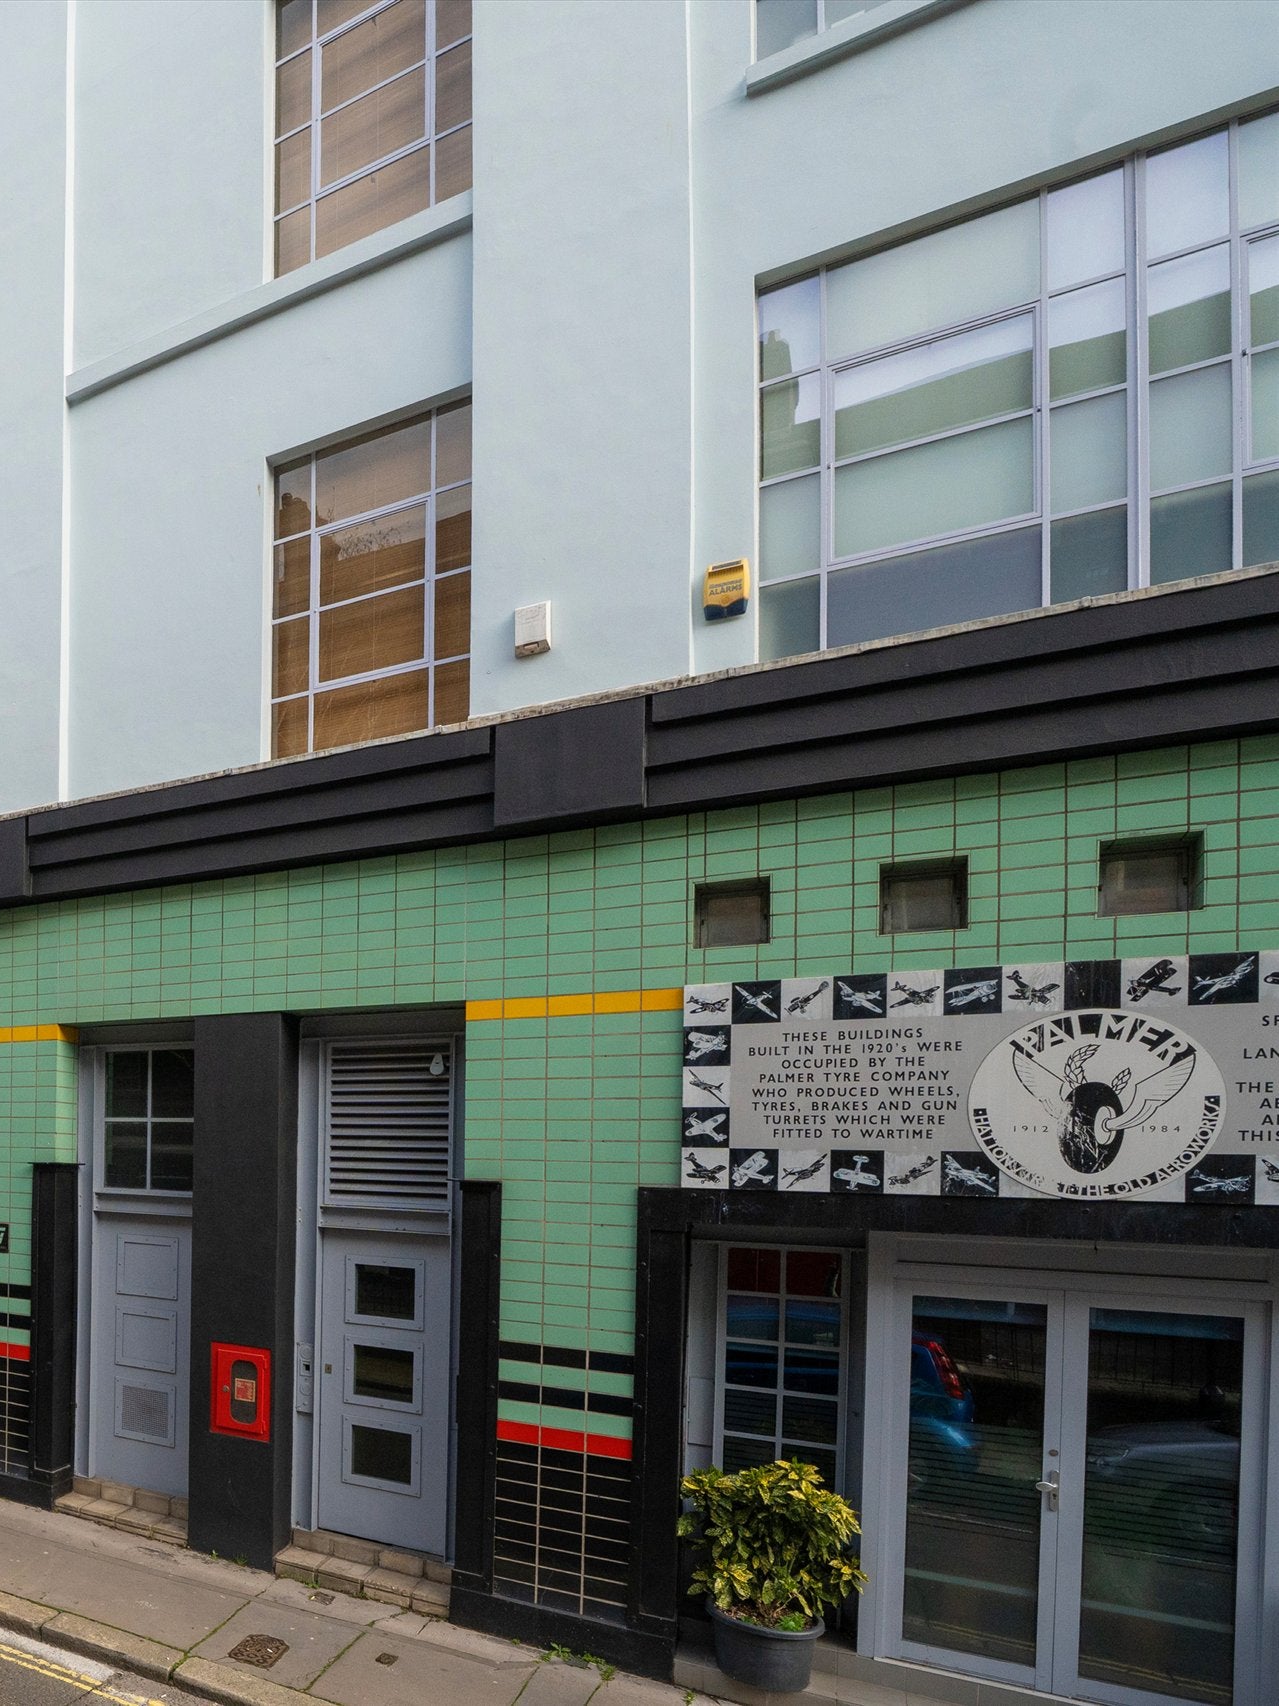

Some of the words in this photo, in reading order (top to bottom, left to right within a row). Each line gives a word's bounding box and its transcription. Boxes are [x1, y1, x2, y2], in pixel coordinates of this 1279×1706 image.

[782, 1031, 828, 1042] THESE
[838, 1028, 923, 1041] BUILDINGS
[1010, 1013, 1197, 1064] PALMER
[748, 1046, 789, 1056] BUILT
[798, 1045, 814, 1055] IN
[823, 1044, 852, 1054] THE
[862, 1043, 907, 1053] 1920's
[917, 1041, 962, 1052] WERE
[781, 1058, 859, 1069] OCCUPIED
[869, 1057, 887, 1067] BY
[895, 1056, 926, 1067] THE
[759, 1073, 815, 1083] PALMER
[823, 1072, 861, 1082] TYRE
[871, 1070, 950, 1081] COMPANY
[752, 1088, 788, 1098] WHO
[797, 1087, 879, 1098] PRODUCED
[888, 1086, 960, 1098] WHEELS,
[1235, 1082, 1274, 1093] THE
[752, 1102, 801, 1113] TYRES,
[811, 1101, 868, 1112] BRAKES
[877, 1101, 912, 1111] AND
[922, 1100, 957, 1110] GUN
[763, 1115, 827, 1125] TURRETS
[835, 1115, 891, 1125] WHICH
[900, 1115, 946, 1125] WERE
[1261, 1114, 1279, 1125] A
[773, 1129, 823, 1139] FITTED
[831, 1129, 851, 1139] TO
[860, 1129, 933, 1139] WARTIME
[1012, 1125, 1049, 1133] 1912
[1142, 1125, 1181, 1133] 1984
[1113, 1176, 1153, 1194] OLD
[1153, 1098, 1220, 1183] AEROWORKS
